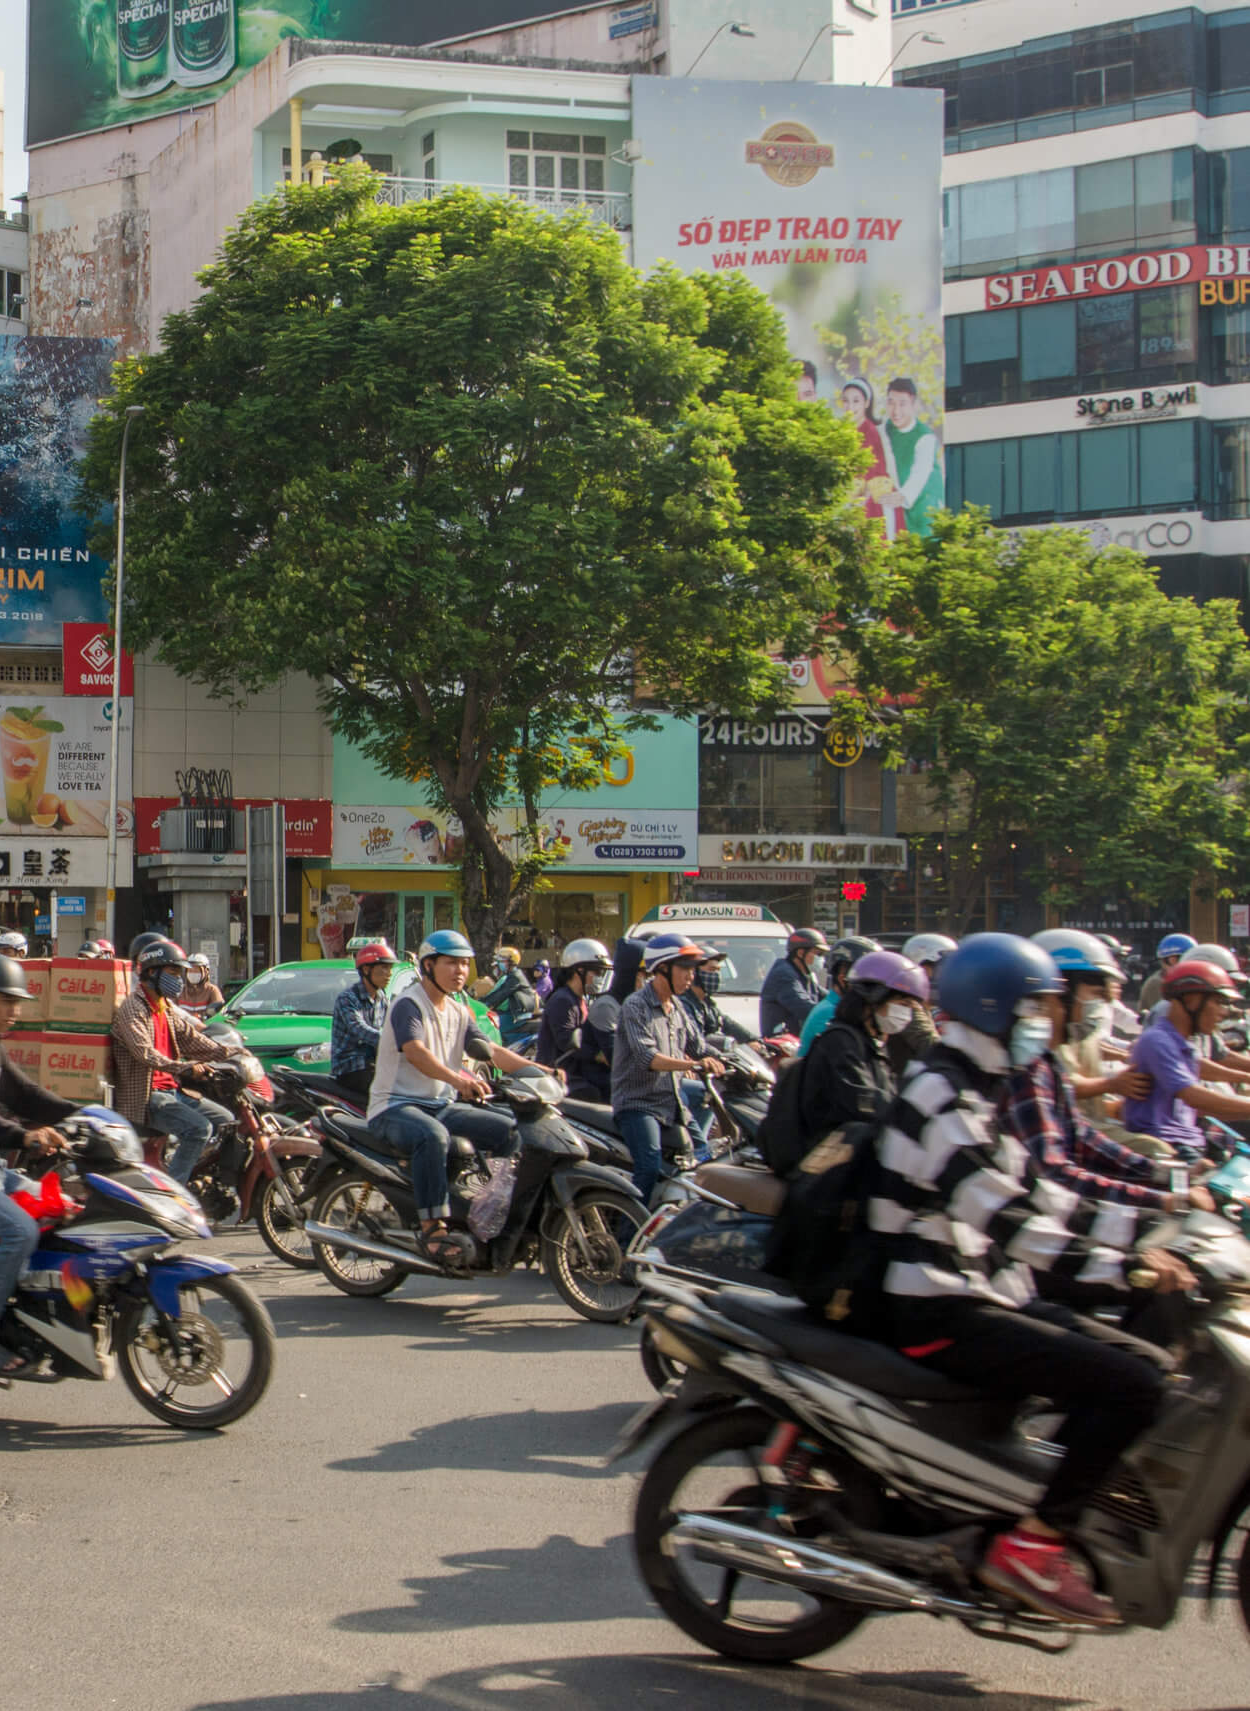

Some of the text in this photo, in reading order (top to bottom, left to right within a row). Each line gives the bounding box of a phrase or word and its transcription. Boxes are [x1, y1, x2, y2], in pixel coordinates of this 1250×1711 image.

[118, 1, 169, 25] SPECIAL
[173, 0, 229, 26] SPECIAL
[748, 143, 833, 163] POWER
[678, 216, 903, 247] SỐ ĐẸP TRAO TAY
[750, 248, 791, 266] MAY
[794, 248, 830, 263] LAN
[989, 252, 1192, 306] SEAFOOD
[1077, 397, 1134, 418] Stone
[17, 546, 90, 563] CHIẾN
[58, 742, 92, 751] WE ARE
[58, 752, 106, 761] DIFFERENT
[58, 762, 97, 771] BECAUSE
[58, 772, 106, 780] WE REALLY
[58, 782, 101, 791] LOVE TEA
[662, 824, 666, 832] 1
[667, 824, 678, 832] LY
[23, 848, 71, 876] 皇茶
[725, 871, 773, 881] BOOKING
[775, 871, 811, 881] OFFICE
[682, 907, 758, 917] VINASUN TAXI
